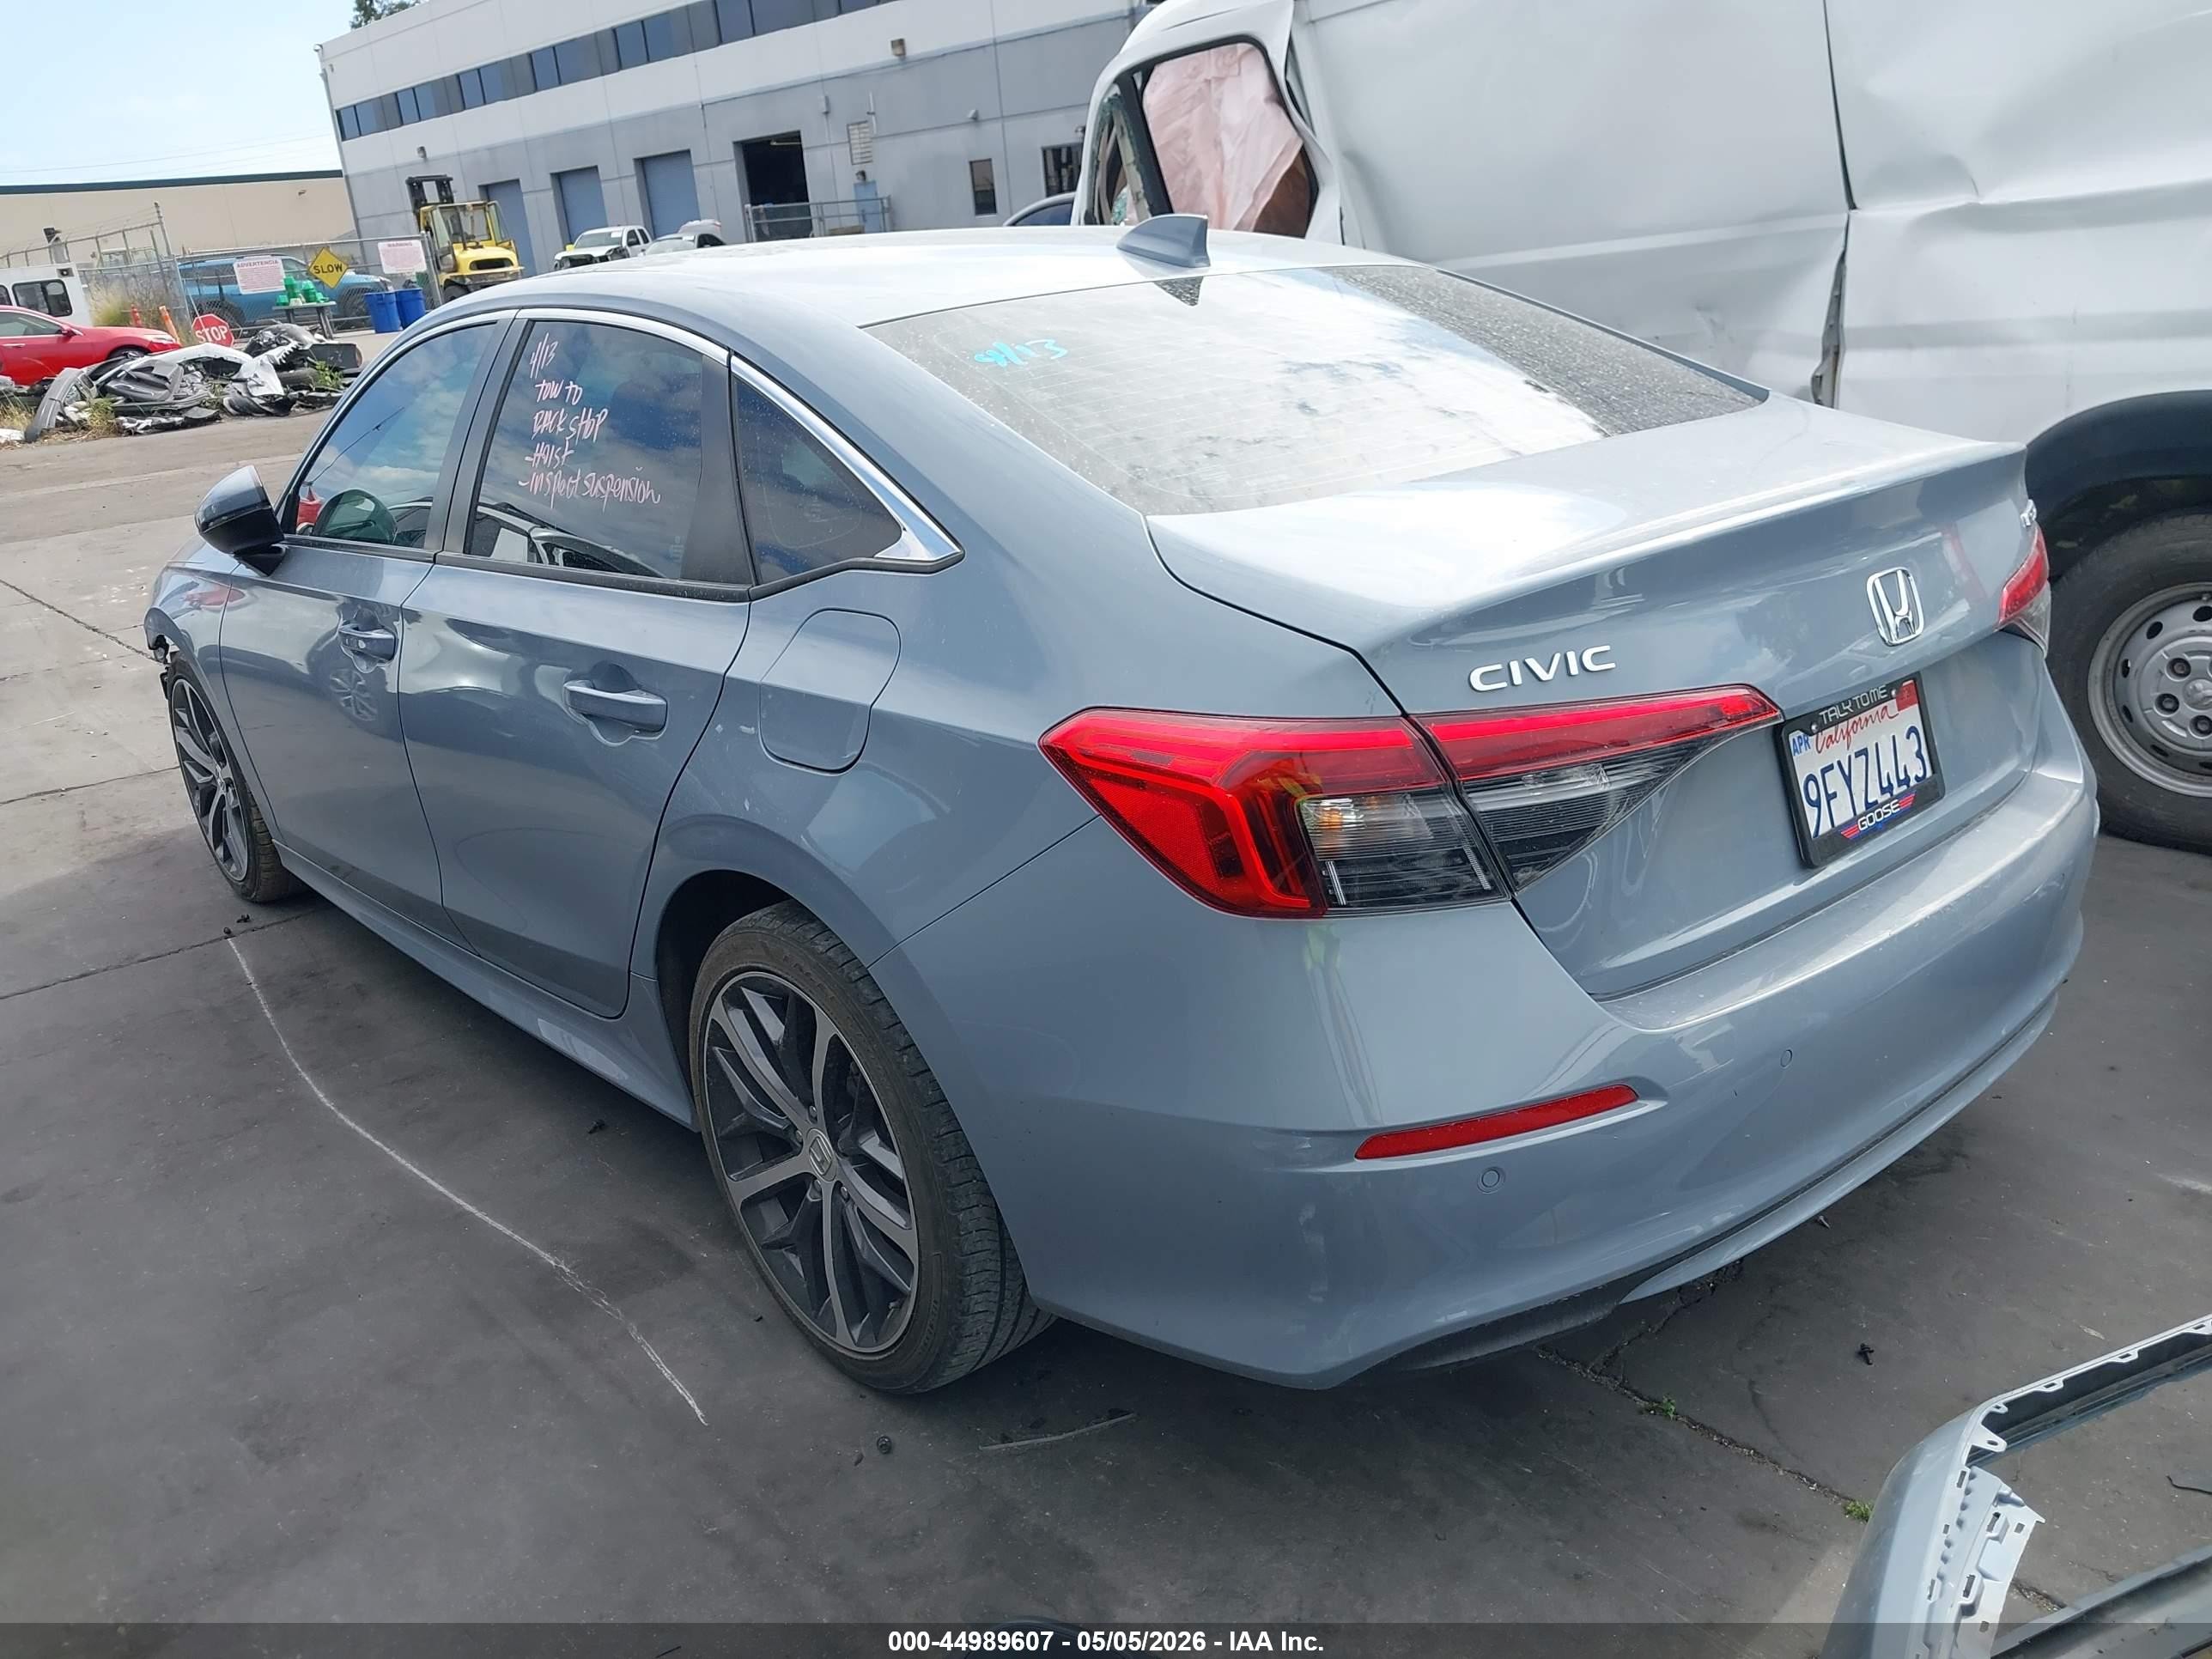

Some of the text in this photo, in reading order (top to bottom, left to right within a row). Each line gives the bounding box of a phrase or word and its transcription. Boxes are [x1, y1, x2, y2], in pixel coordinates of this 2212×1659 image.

[313, 264, 343, 274] SLOW
[195, 325, 228, 343] STOP
[1469, 644, 1616, 692] CIVIC
[1819, 699, 1853, 725] TALK
[1852, 690, 1870, 709] TO
[1869, 684, 1889, 702] ME
[1791, 734, 1811, 757] APR
[1814, 704, 1899, 754] California
[1803, 726, 1928, 839] 9FYZ443
[1856, 799, 1900, 831] GOOSE
